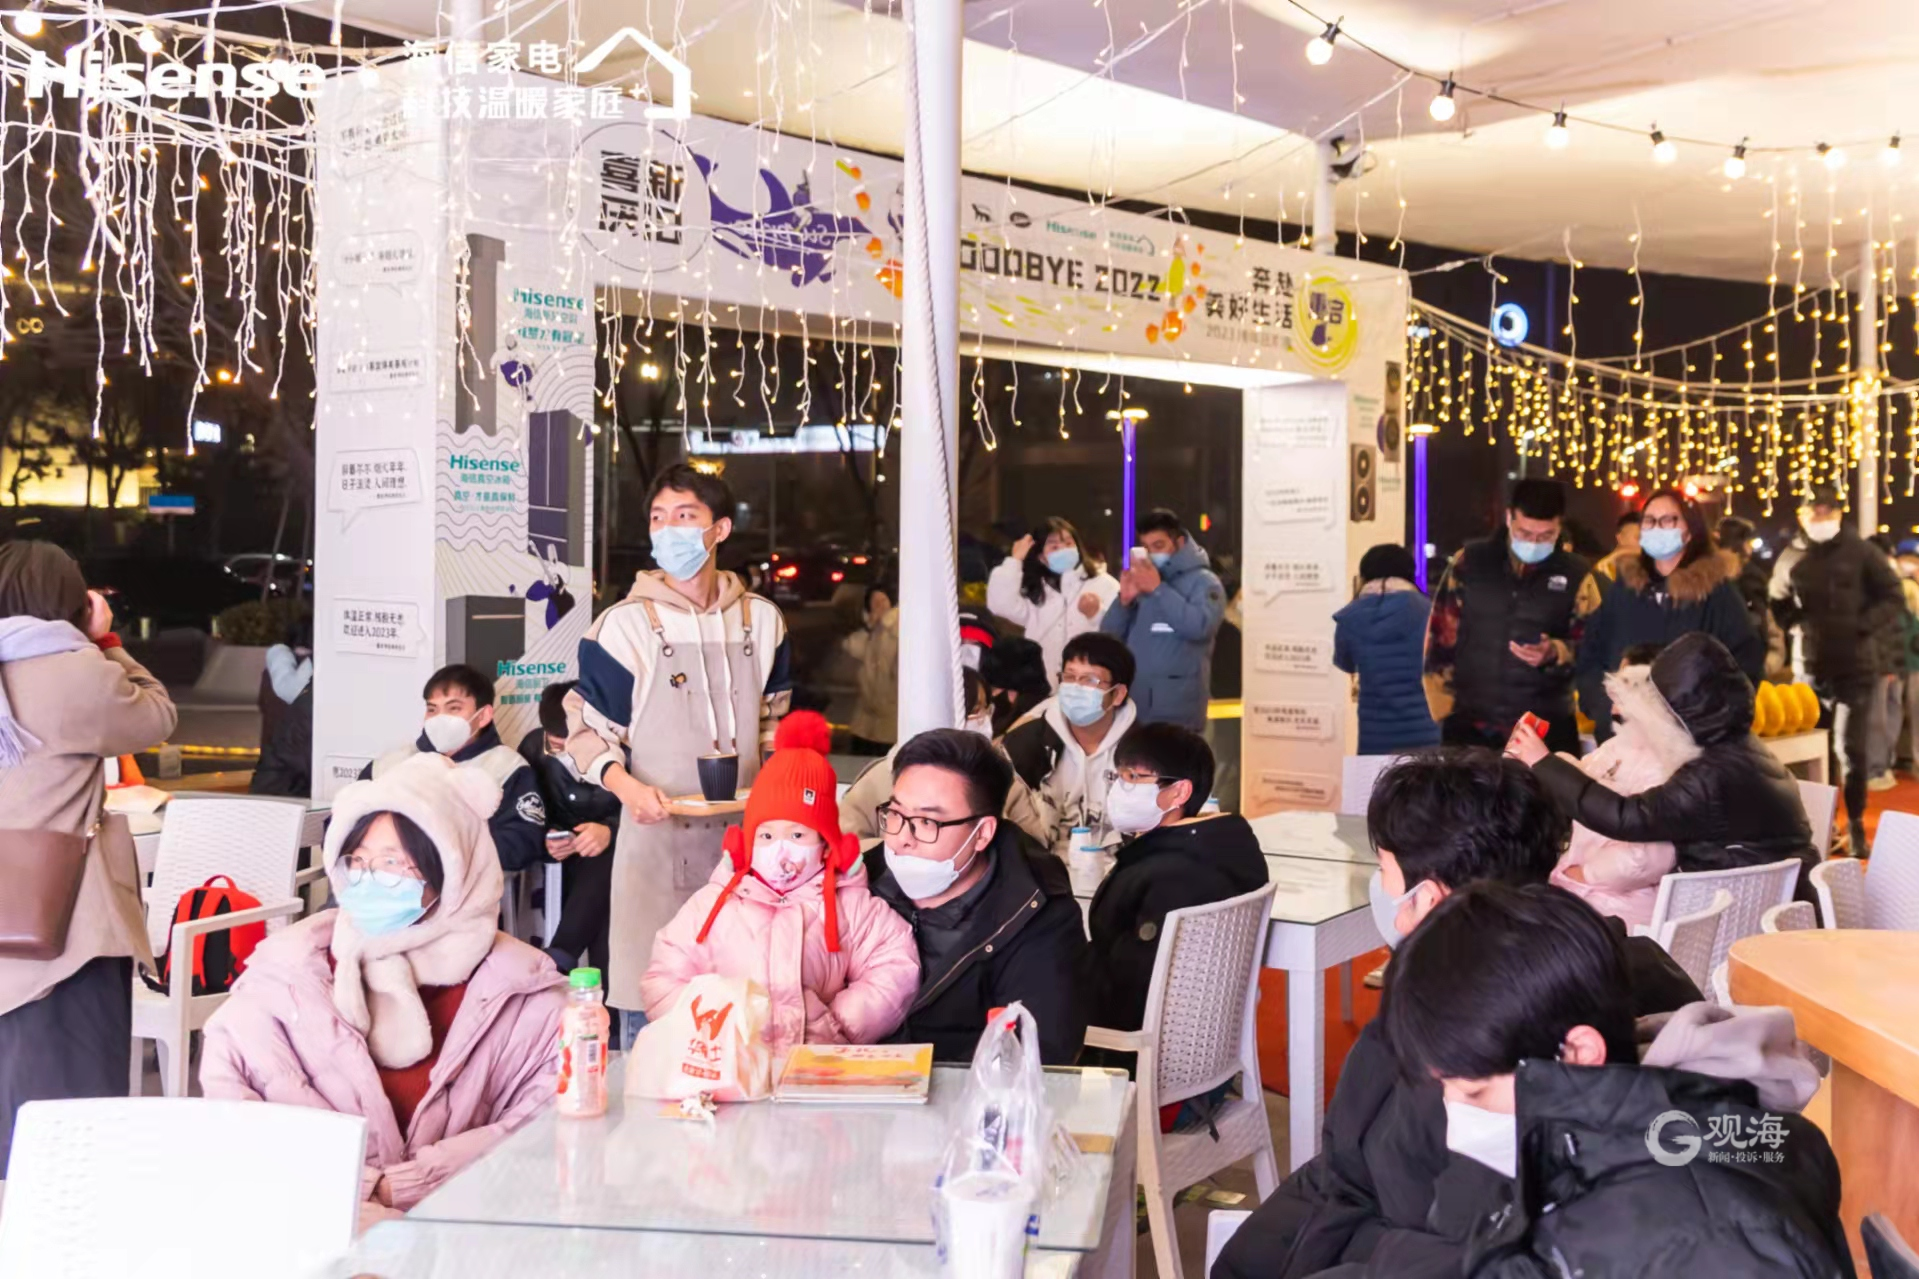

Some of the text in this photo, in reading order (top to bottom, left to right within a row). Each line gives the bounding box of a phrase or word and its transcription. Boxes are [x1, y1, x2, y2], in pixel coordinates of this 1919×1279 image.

[1046, 220, 1097, 240] Hisese
[960, 238, 1084, 289] OODBYE
[1095, 264, 1161, 301] 2022
[450, 454, 520, 472] Hisense
[497, 659, 567, 677] Hisense
